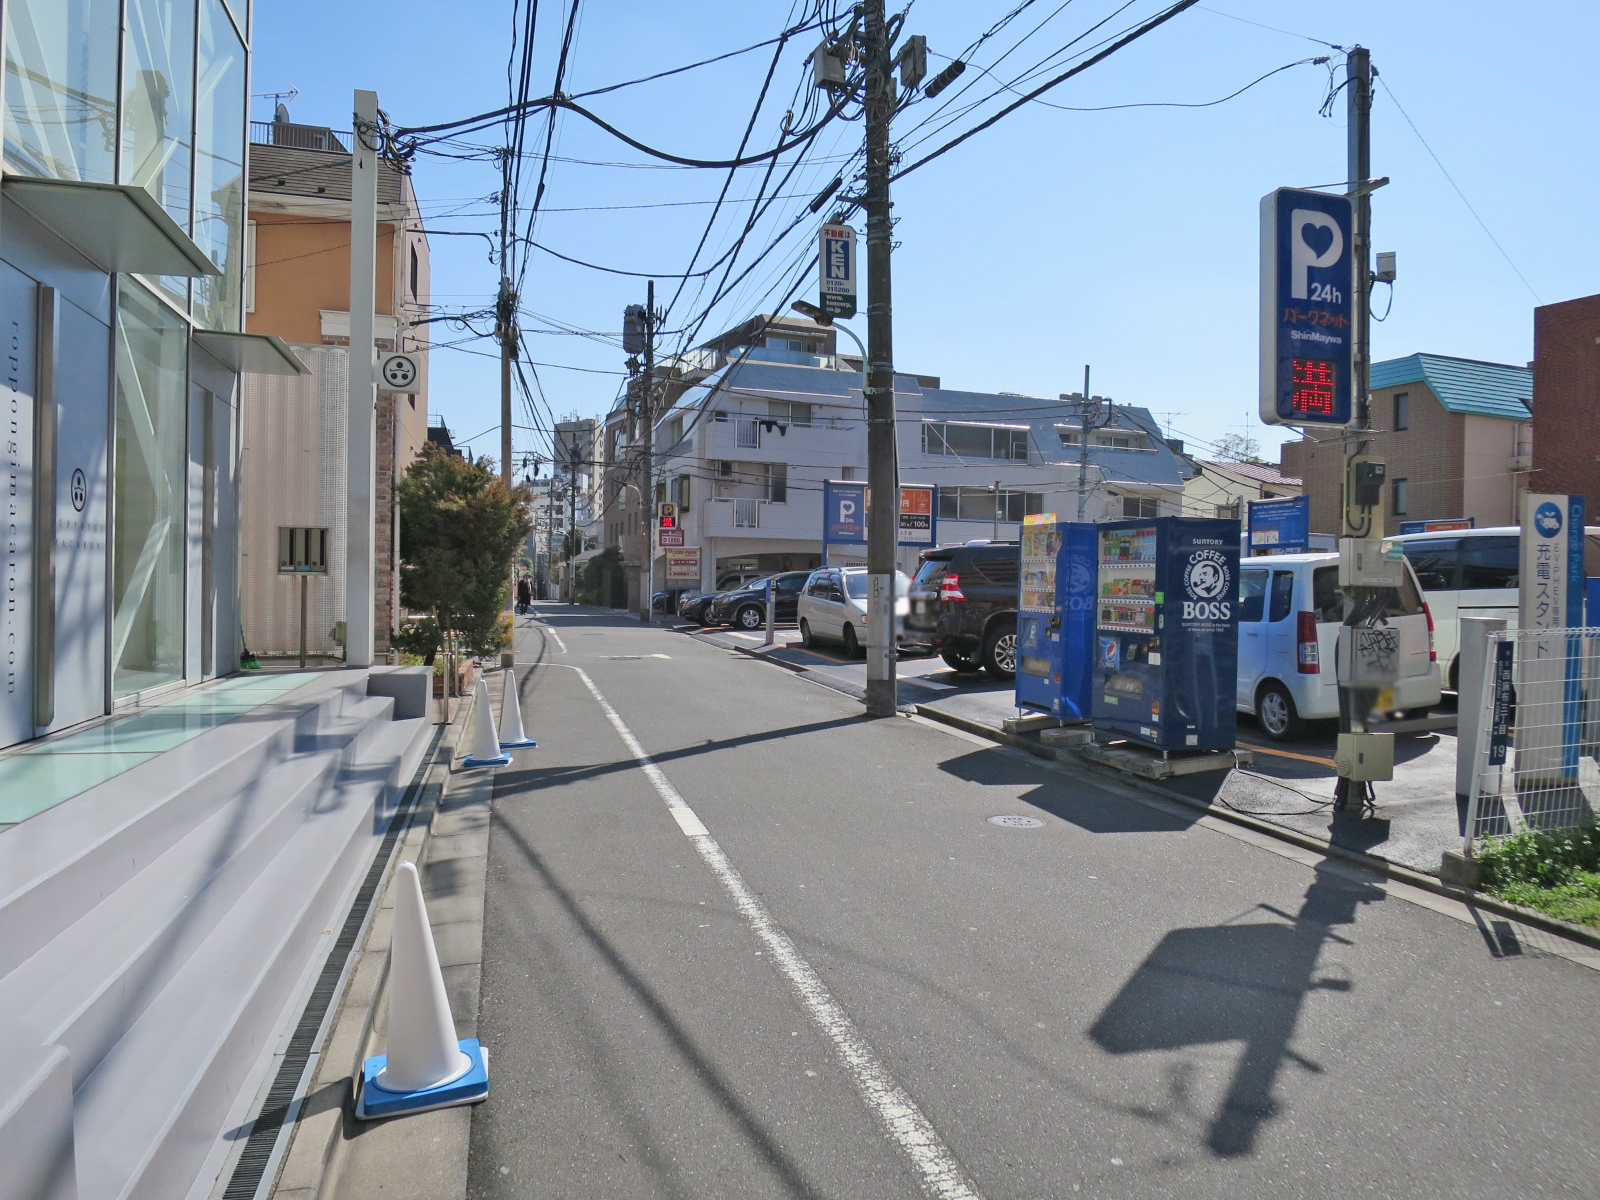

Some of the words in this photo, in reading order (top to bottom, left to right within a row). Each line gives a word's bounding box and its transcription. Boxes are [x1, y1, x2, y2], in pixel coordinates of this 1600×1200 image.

[824, 228, 850, 239] 不動産は
[831, 240, 844, 279] KEN
[1291, 208, 1343, 299] P
[1310, 282, 1341, 304] 24h
[1283, 307, 1349, 328] パークネット
[1291, 330, 1342, 344] ShinMaywa
[1292, 360, 1333, 414] 満
[7, 320, 20, 695] roppongimacaron.com
[1569, 504, 1582, 549] Charge
[1189, 549, 1227, 565] COFFEE
[1570, 553, 1580, 582] Park
[1182, 601, 1231, 620] BOSS
[1536, 543, 1551, 659] 充電スタンド
[1492, 745, 1505, 758] 19
